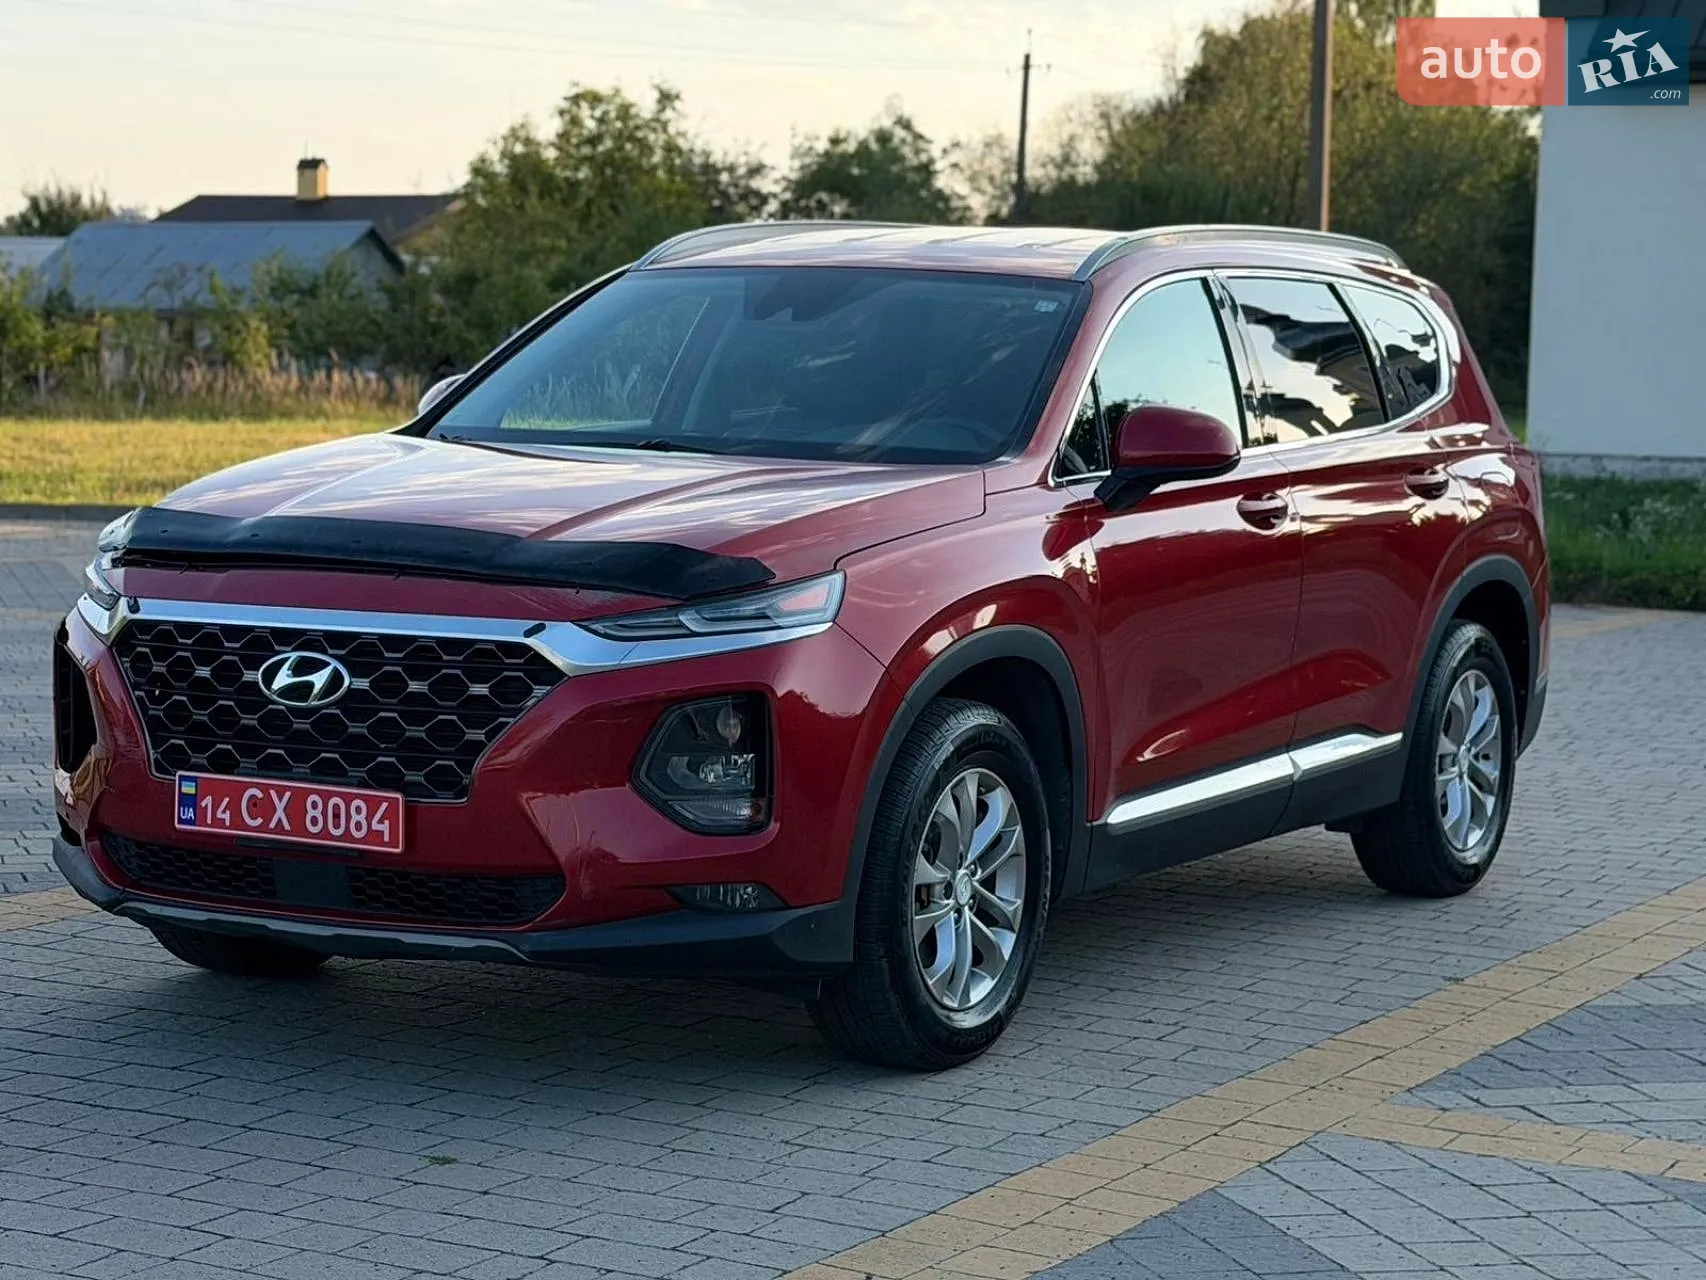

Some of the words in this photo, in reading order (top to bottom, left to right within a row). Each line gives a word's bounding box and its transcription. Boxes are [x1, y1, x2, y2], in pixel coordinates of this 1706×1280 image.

[180, 806, 195, 820] UA
[200, 795, 230, 827] 14
[241, 787, 291, 831] CX
[305, 794, 390, 842] 8084
